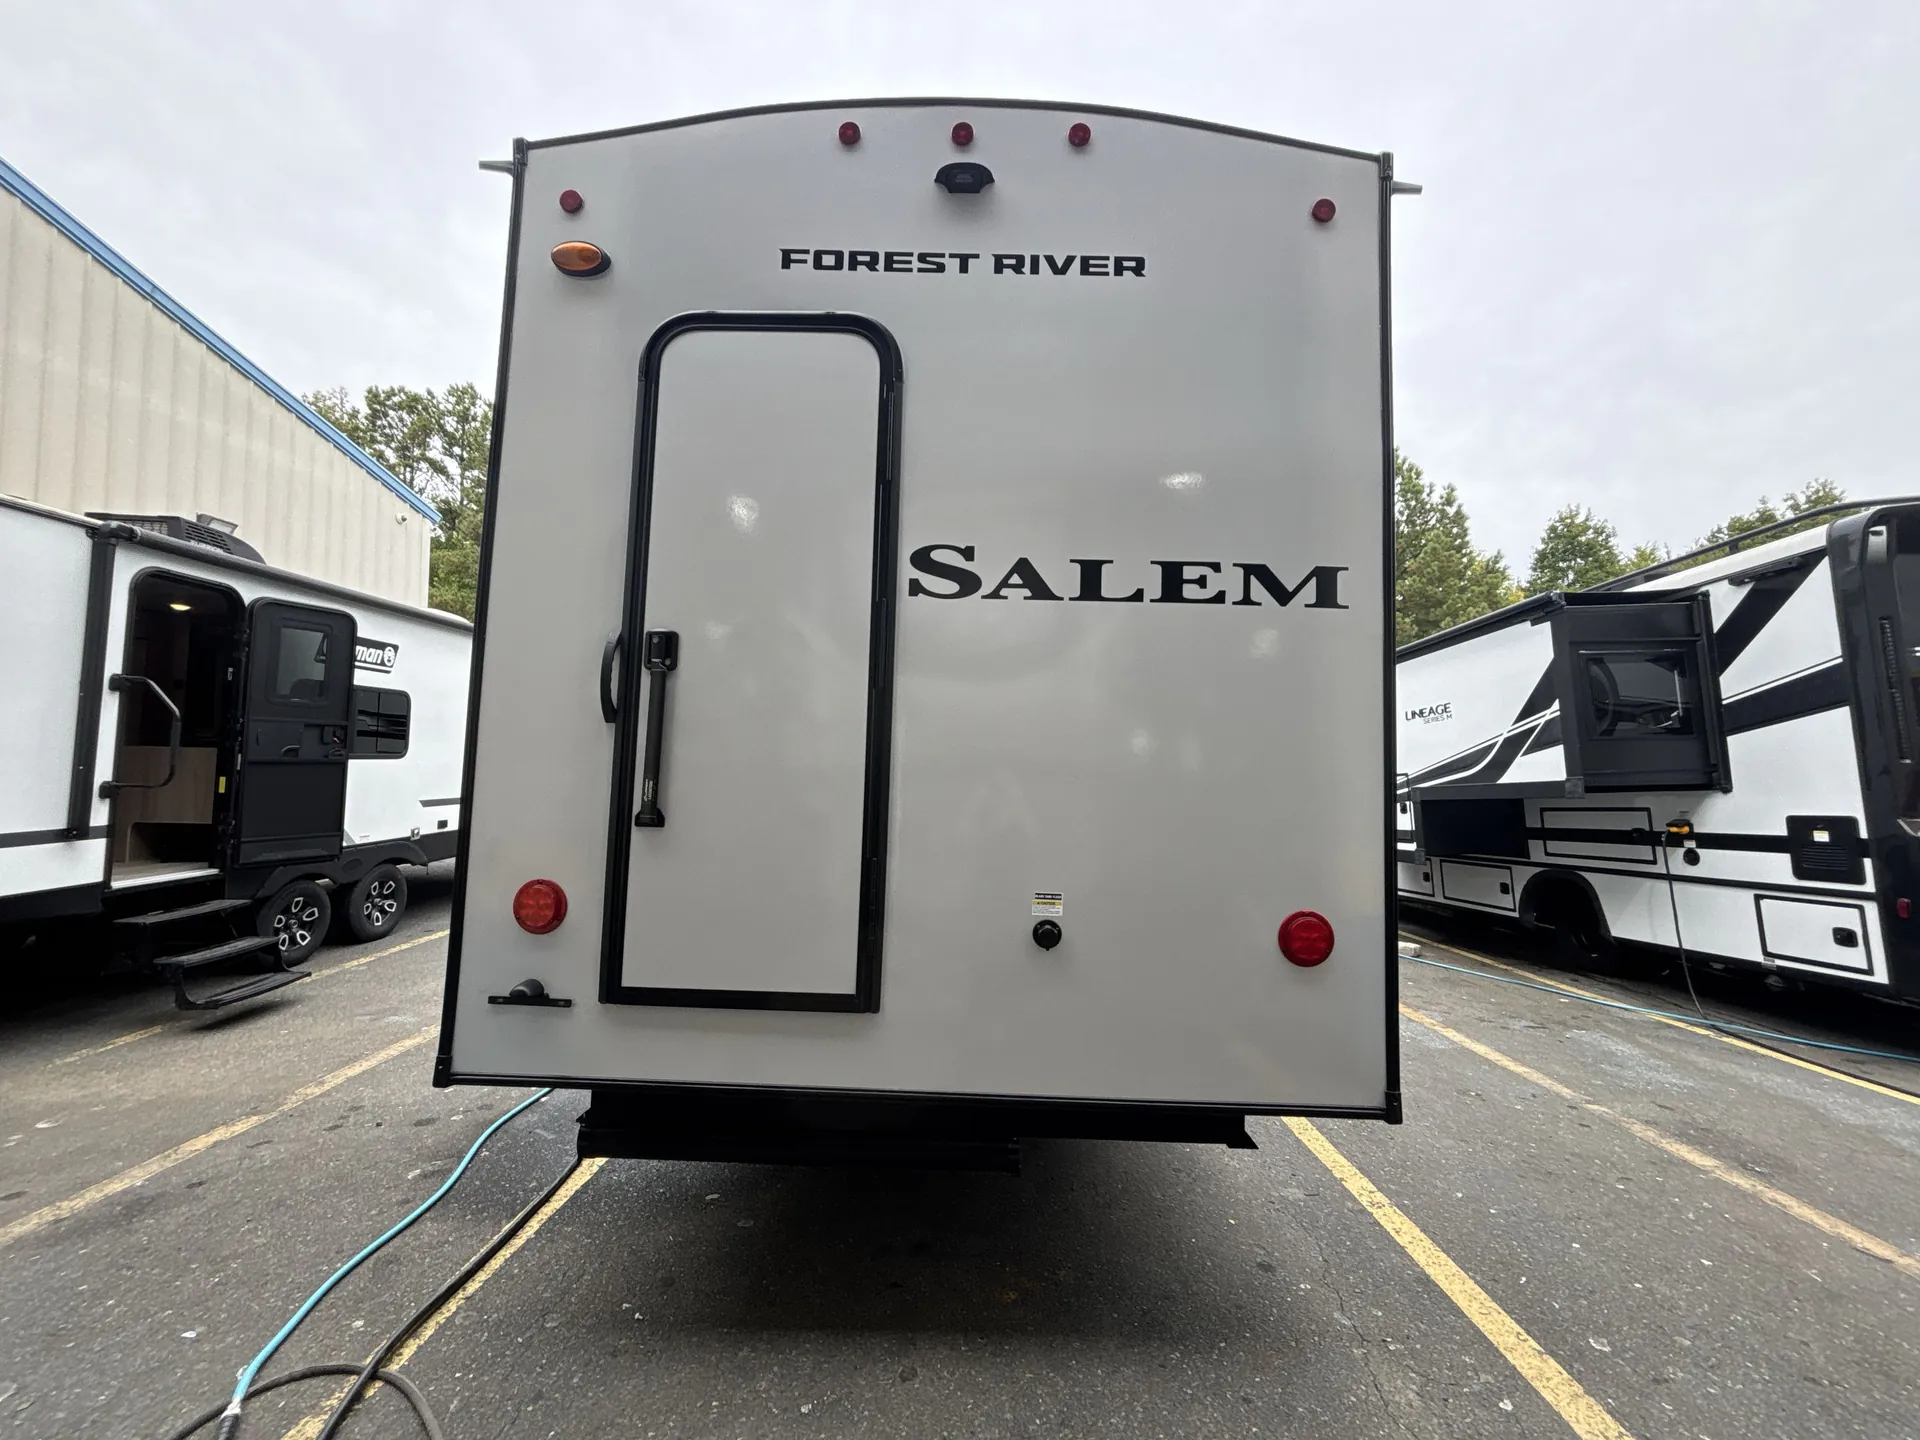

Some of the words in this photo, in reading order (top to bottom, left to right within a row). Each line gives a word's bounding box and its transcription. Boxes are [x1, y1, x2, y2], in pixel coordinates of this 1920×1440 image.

[779, 248, 980, 274] FOREST
[992, 253, 1146, 277] RIVER
[908, 544, 1350, 609] SALEM
[1405, 702, 1451, 721] LINEAGE
[1423, 714, 1445, 724] SERIES
